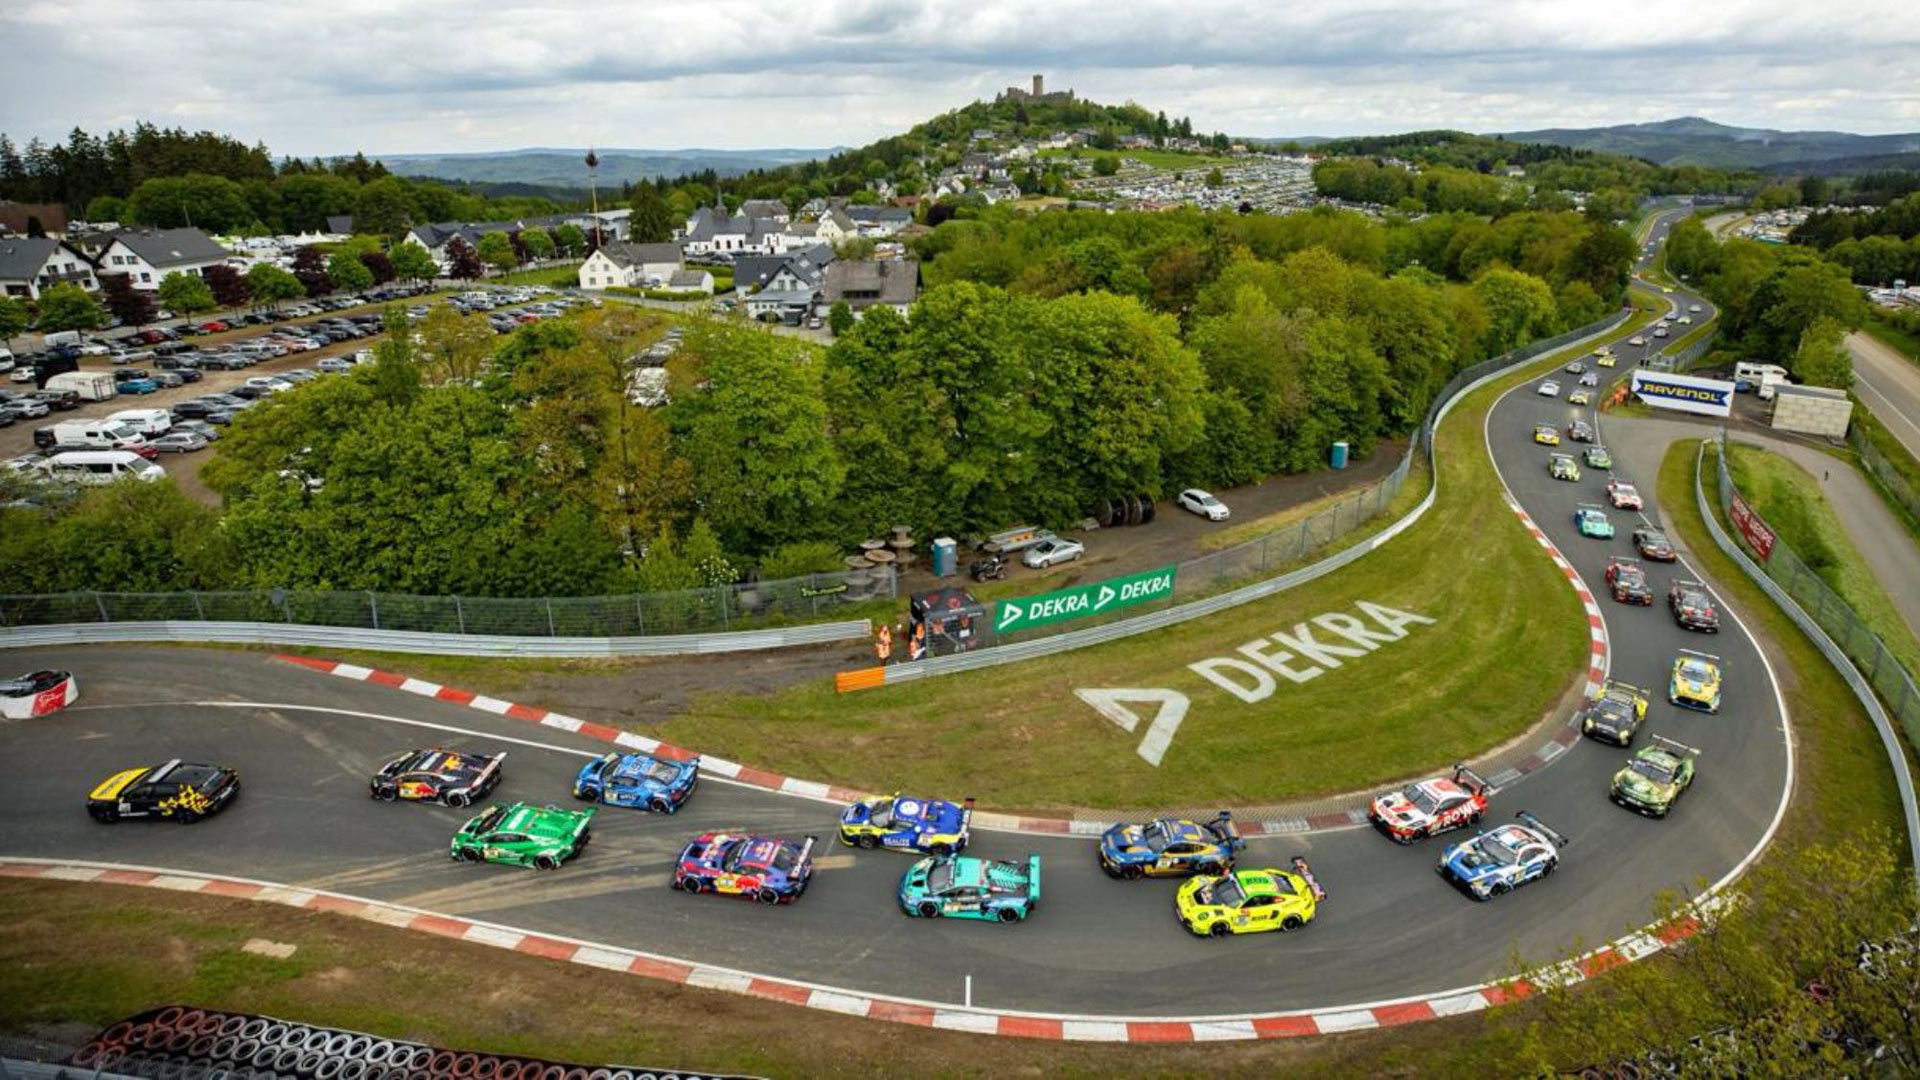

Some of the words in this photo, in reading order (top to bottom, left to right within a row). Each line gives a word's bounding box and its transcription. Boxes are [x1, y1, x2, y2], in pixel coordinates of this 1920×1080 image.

[1644, 384, 1718, 402] RAVENOL
[1120, 574, 1171, 601] DEKRA
[1029, 593, 1089, 620] DEKRA
[1186, 600, 1437, 704] DEKRA
